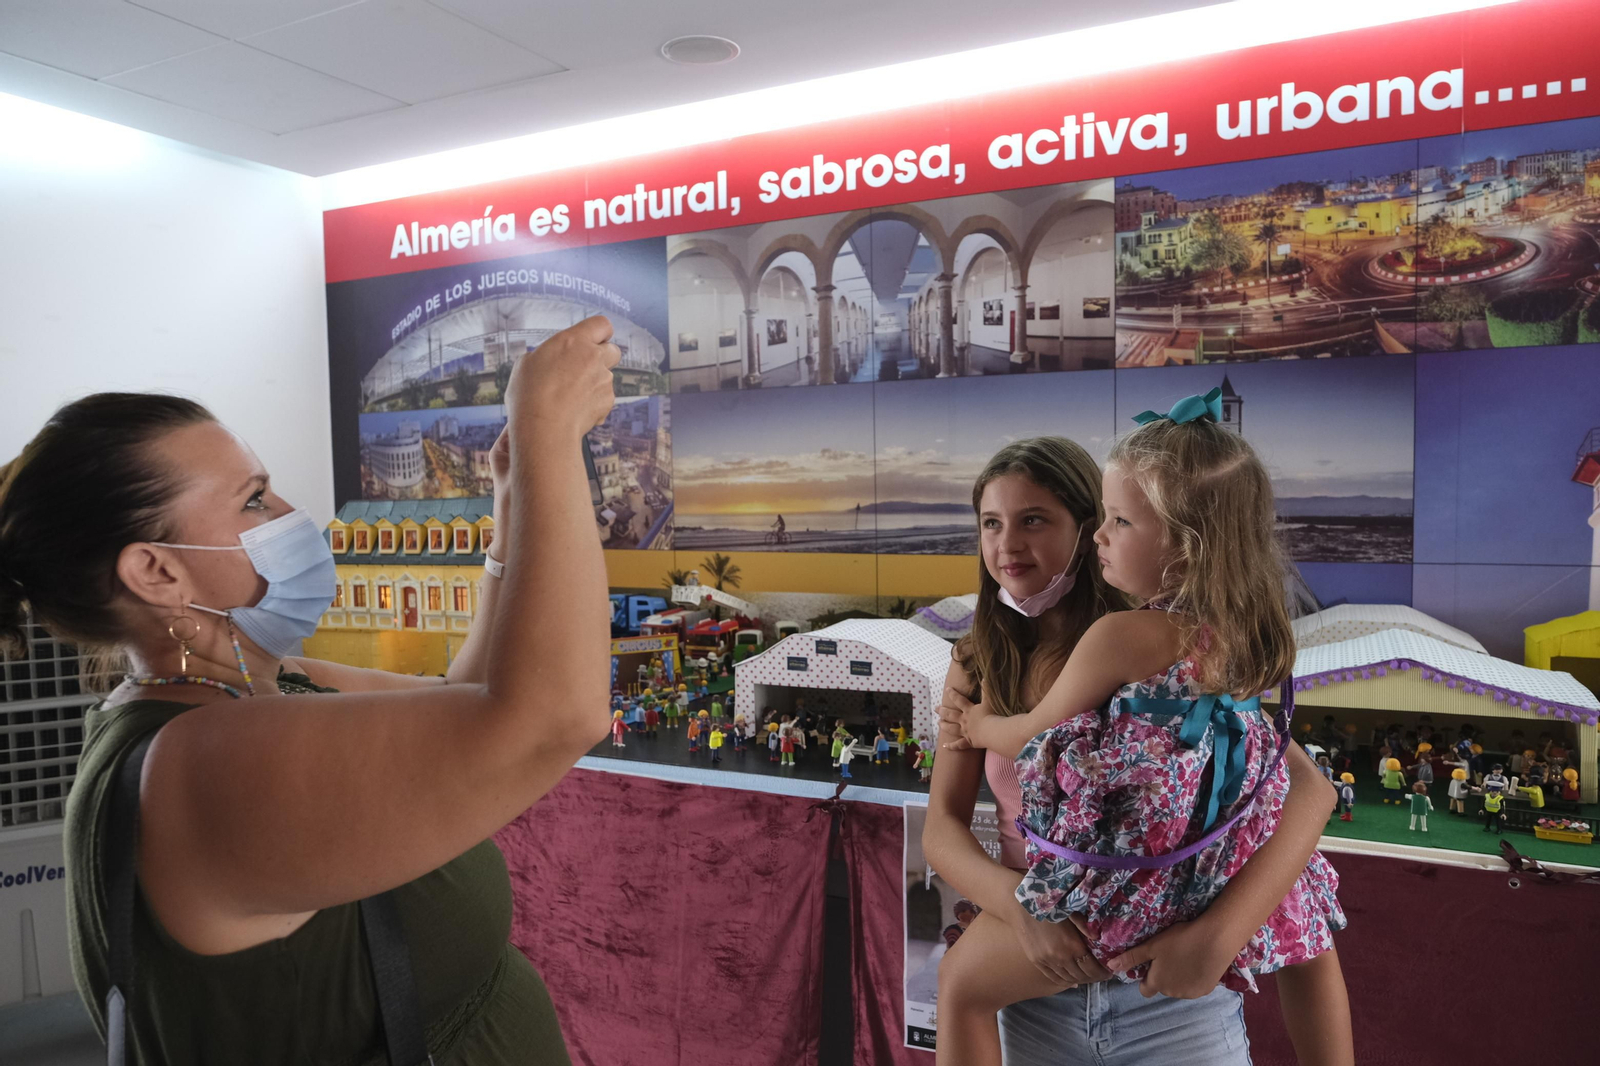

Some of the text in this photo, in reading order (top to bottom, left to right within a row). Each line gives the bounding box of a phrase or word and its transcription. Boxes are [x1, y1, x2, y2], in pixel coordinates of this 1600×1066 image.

[390, 206, 516, 259] Almería
[529, 204, 570, 237] es
[583, 170, 741, 229] natural,
[758, 143, 966, 204] sabrosa,
[987, 111, 1187, 170] activa,
[391, 305, 422, 340] ESTADIO
[425, 294, 441, 313] DE
[445, 279, 472, 303] LOS
[477, 268, 539, 291] JUEGOS
[618, 639, 662, 653] CIRCUS
